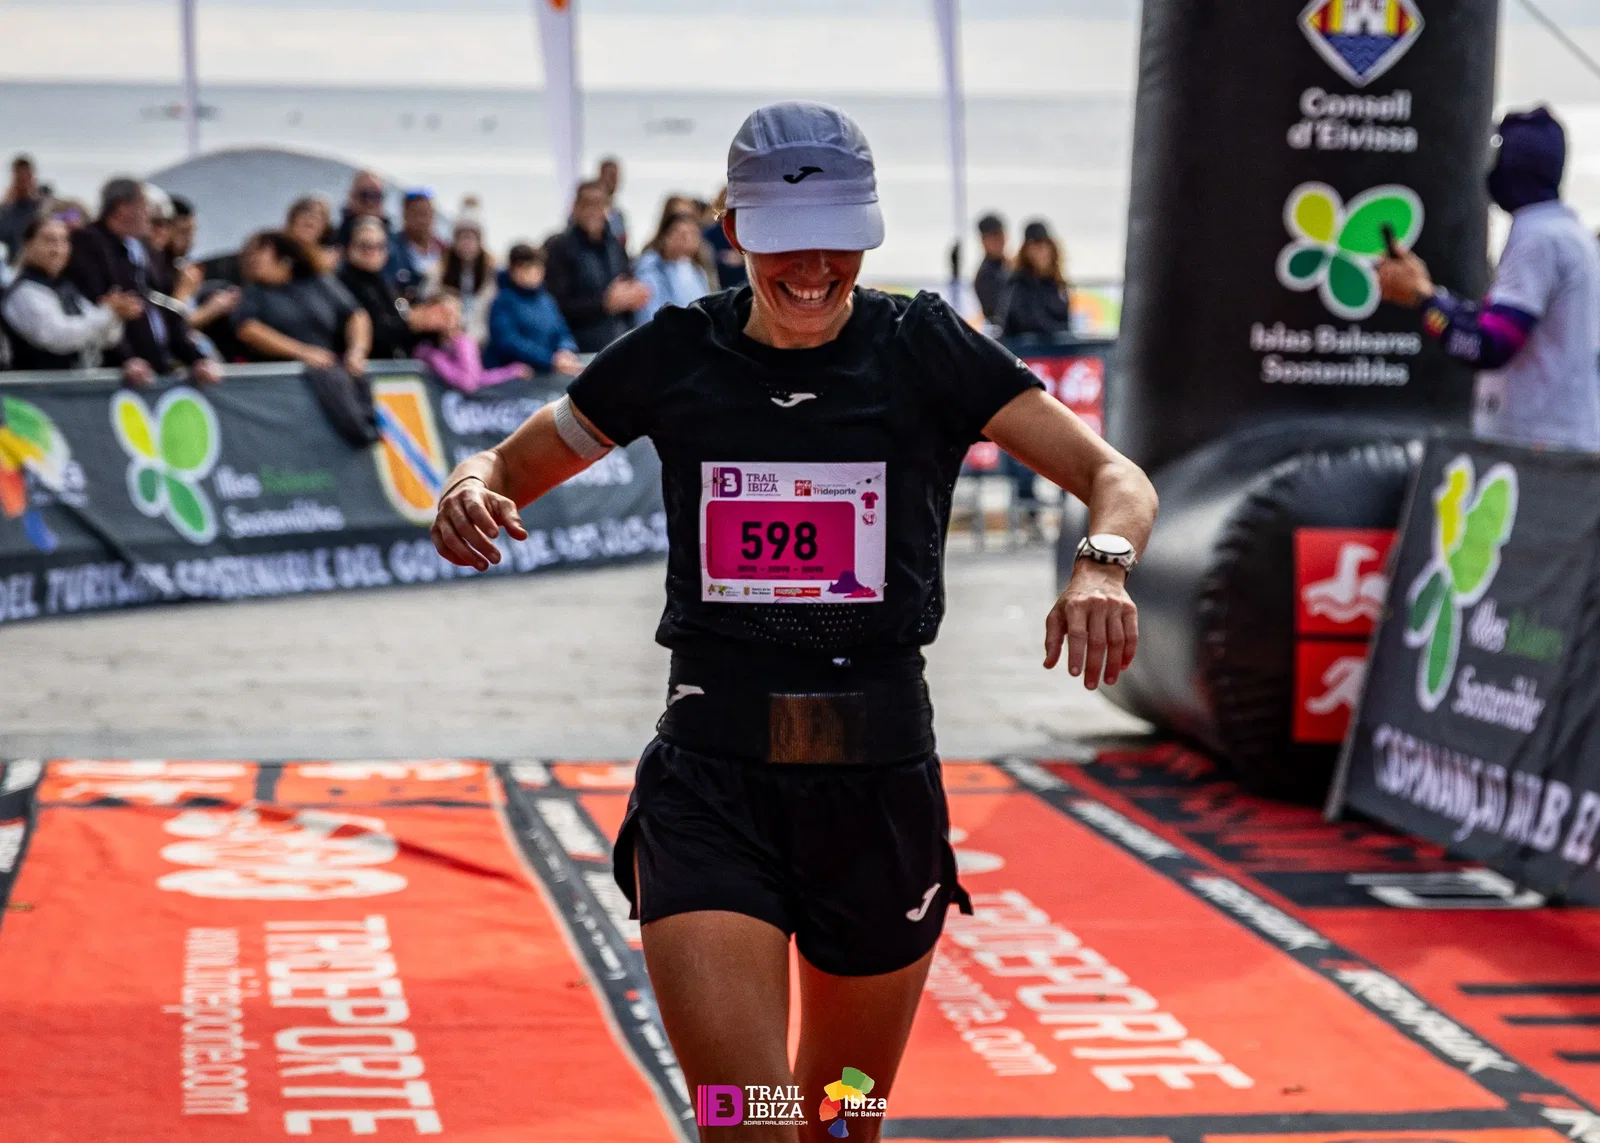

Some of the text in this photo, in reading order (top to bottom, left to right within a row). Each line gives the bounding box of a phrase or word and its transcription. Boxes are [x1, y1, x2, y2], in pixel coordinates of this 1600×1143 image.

[1299, 86, 1412, 122] Consell
[1286, 118, 1419, 152] d'Eivissa
[1260, 353, 1410, 386] Sostenibles
[746, 473, 779, 483] TRAIL
[748, 483, 778, 492] IBIZA
[813, 487, 857, 496] Trideporte
[740, 521, 818, 561] 598
[263, 914, 443, 1135] TRIDEPORTE
